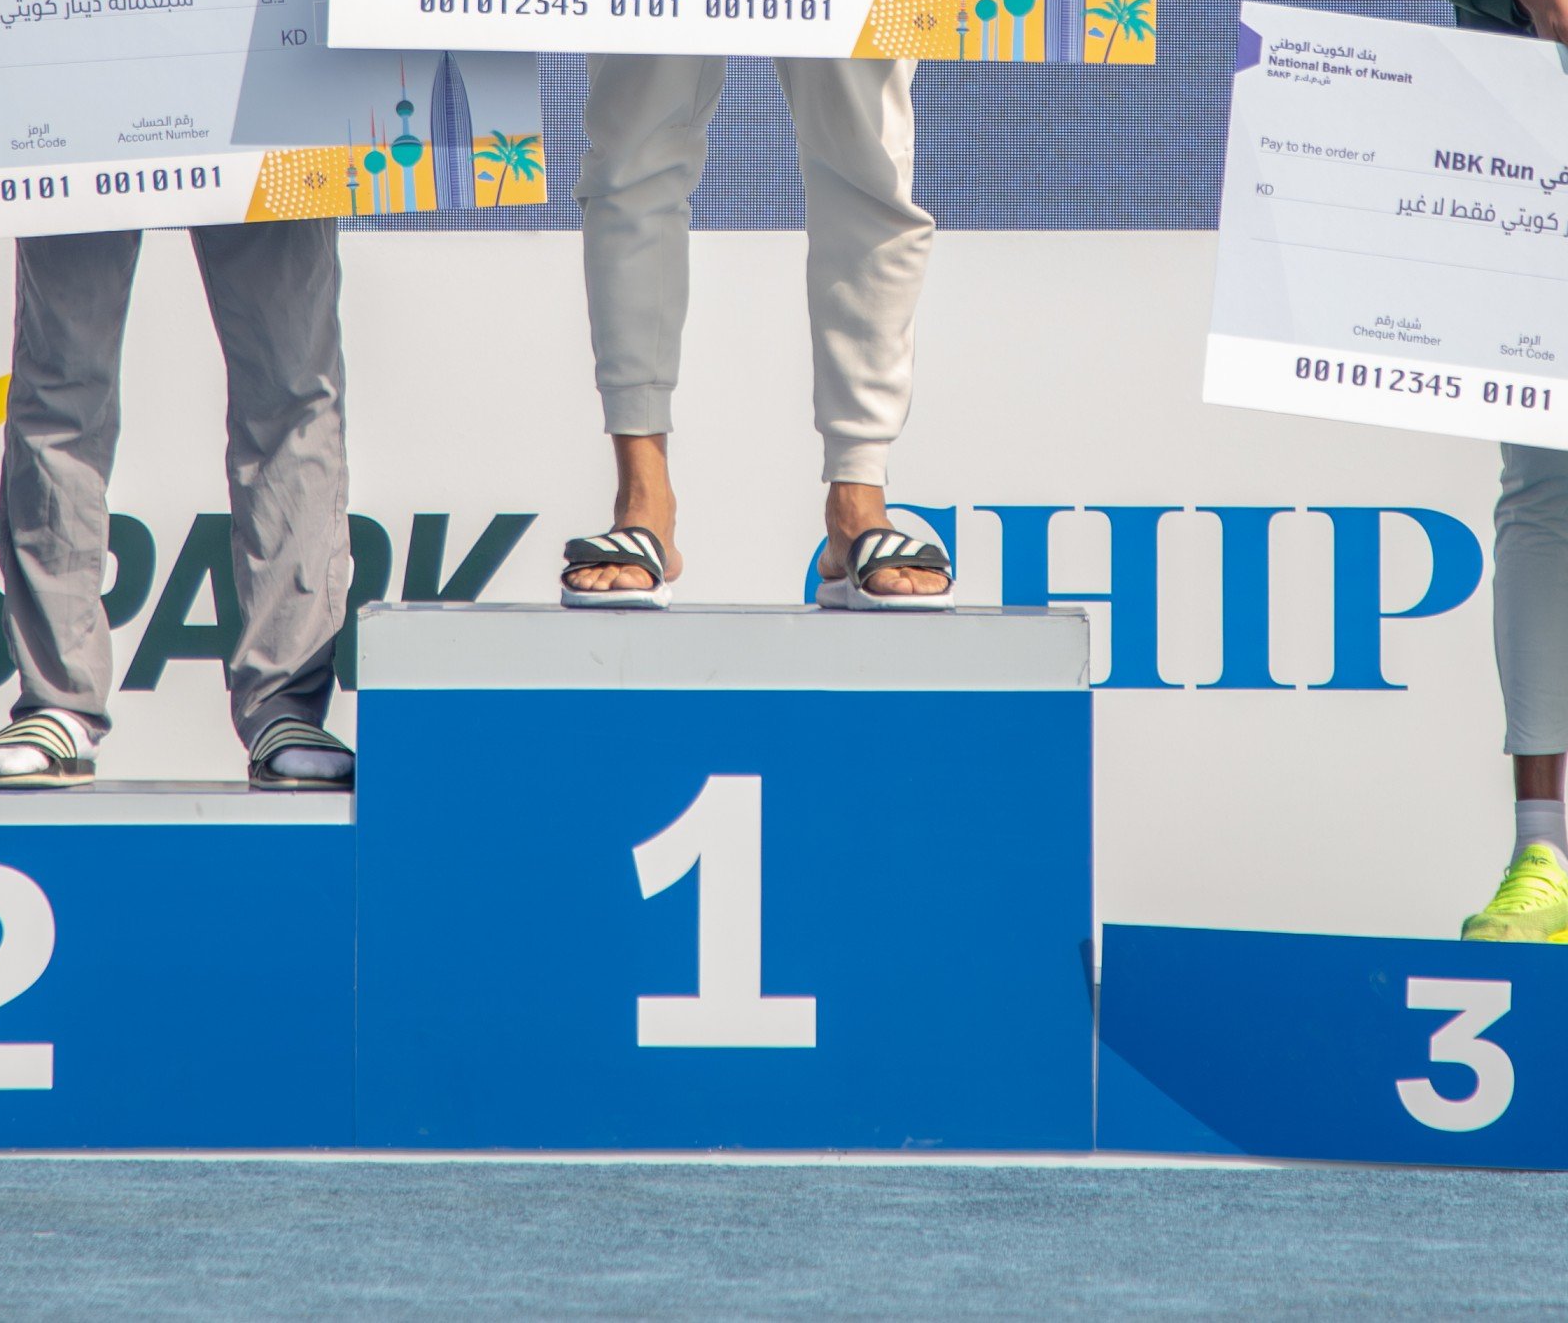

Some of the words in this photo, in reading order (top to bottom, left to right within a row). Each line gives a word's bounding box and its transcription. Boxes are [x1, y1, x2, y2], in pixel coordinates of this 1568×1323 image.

[281, 29, 307, 46] KD
[1268, 55, 1319, 73] National
[1322, 62, 1353, 77] Bank
[1371, 68, 1413, 85] Kuwait
[11, 138, 34, 151] Sort
[36, 137, 67, 150] Code
[117, 130, 164, 144] Account
[165, 128, 210, 141] Number
[1261, 137, 1284, 154] Pay
[1301, 141, 1323, 156] the
[1325, 145, 1360, 162] order
[1433, 150, 1484, 174] NBK
[1491, 157, 1534, 181] Run
[0, 174, 72, 203] 0101
[95, 164, 223, 196] 0010101
[1256, 182, 1275, 196] KD
[1396, 194, 1427, 217] غير
[1450, 199, 1496, 223] فقط
[1501, 207, 1558, 236] كويتي
[1353, 325, 1396, 342] Cheque
[1398, 331, 1442, 347] Number
[1500, 344, 1525, 359] Sort
[1526, 348, 1556, 363] Code
[1295, 356, 1462, 399] 001012345
[1482, 380, 1552, 412] 0101
[631, 775, 819, 1049] 1
[1395, 978, 1516, 1132] 3
